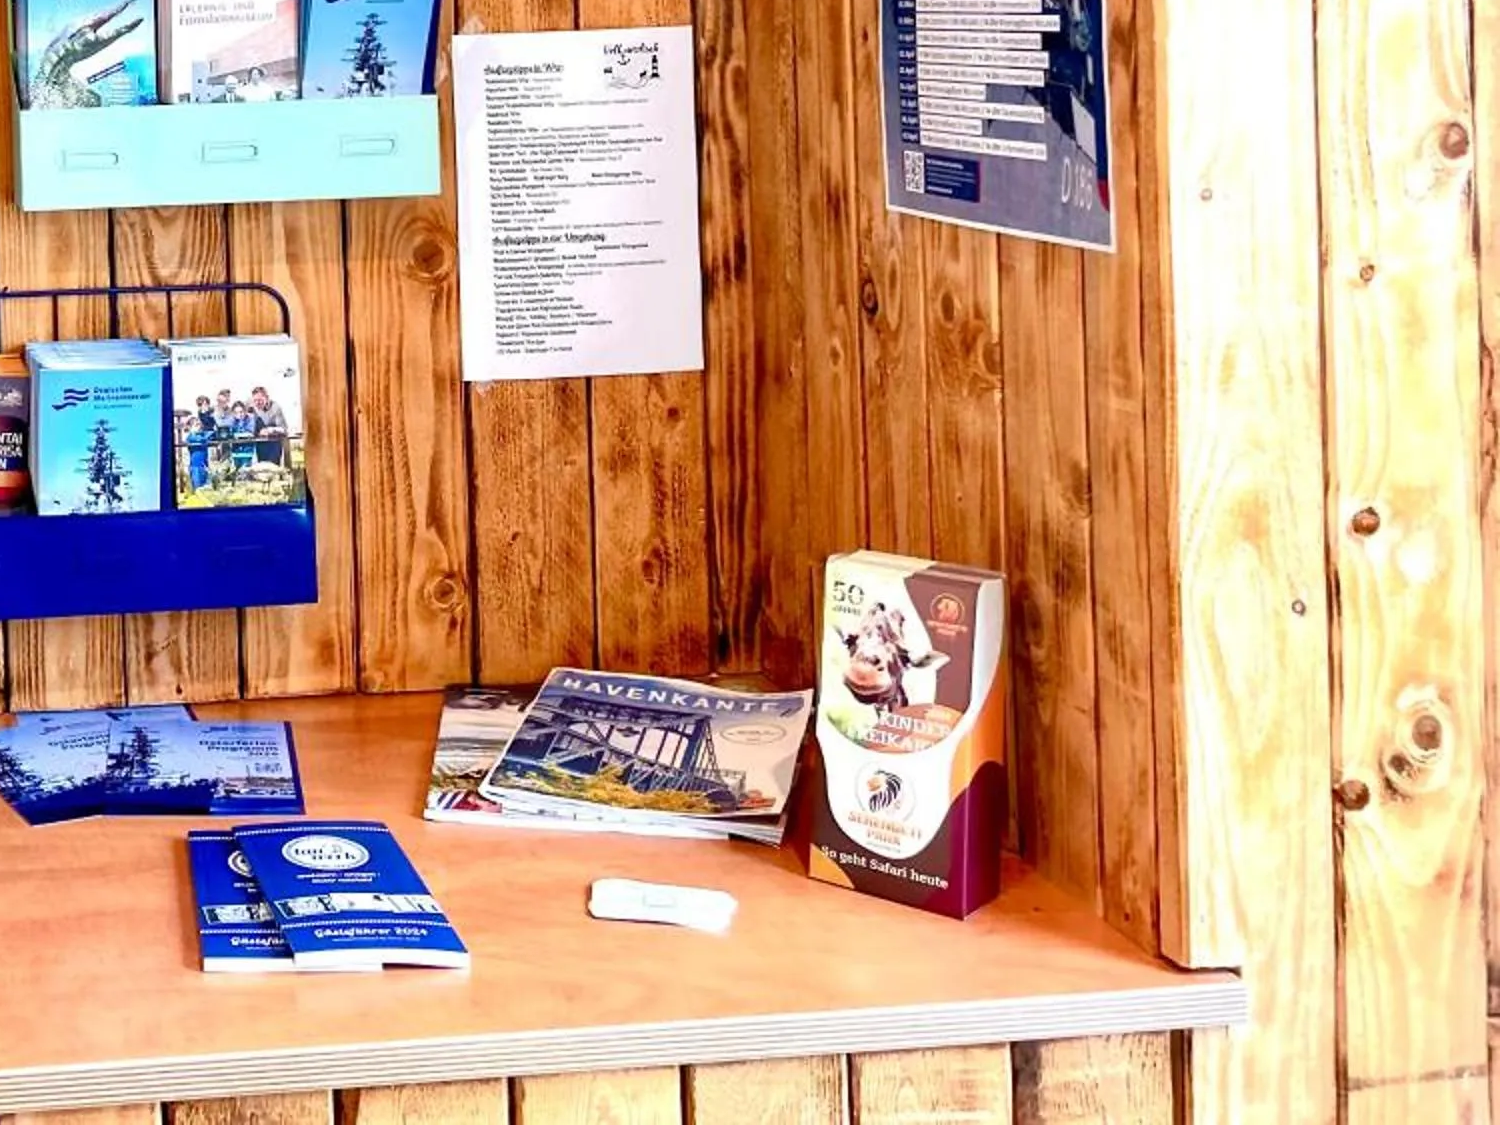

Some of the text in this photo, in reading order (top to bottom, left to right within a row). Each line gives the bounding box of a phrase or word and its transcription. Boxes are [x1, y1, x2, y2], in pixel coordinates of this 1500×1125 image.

[832, 580, 865, 606] 50
[563, 677, 781, 712] HAVENKANTE
[821, 846, 949, 890] So geht Safari heute
[392, 925, 428, 937] 2024
